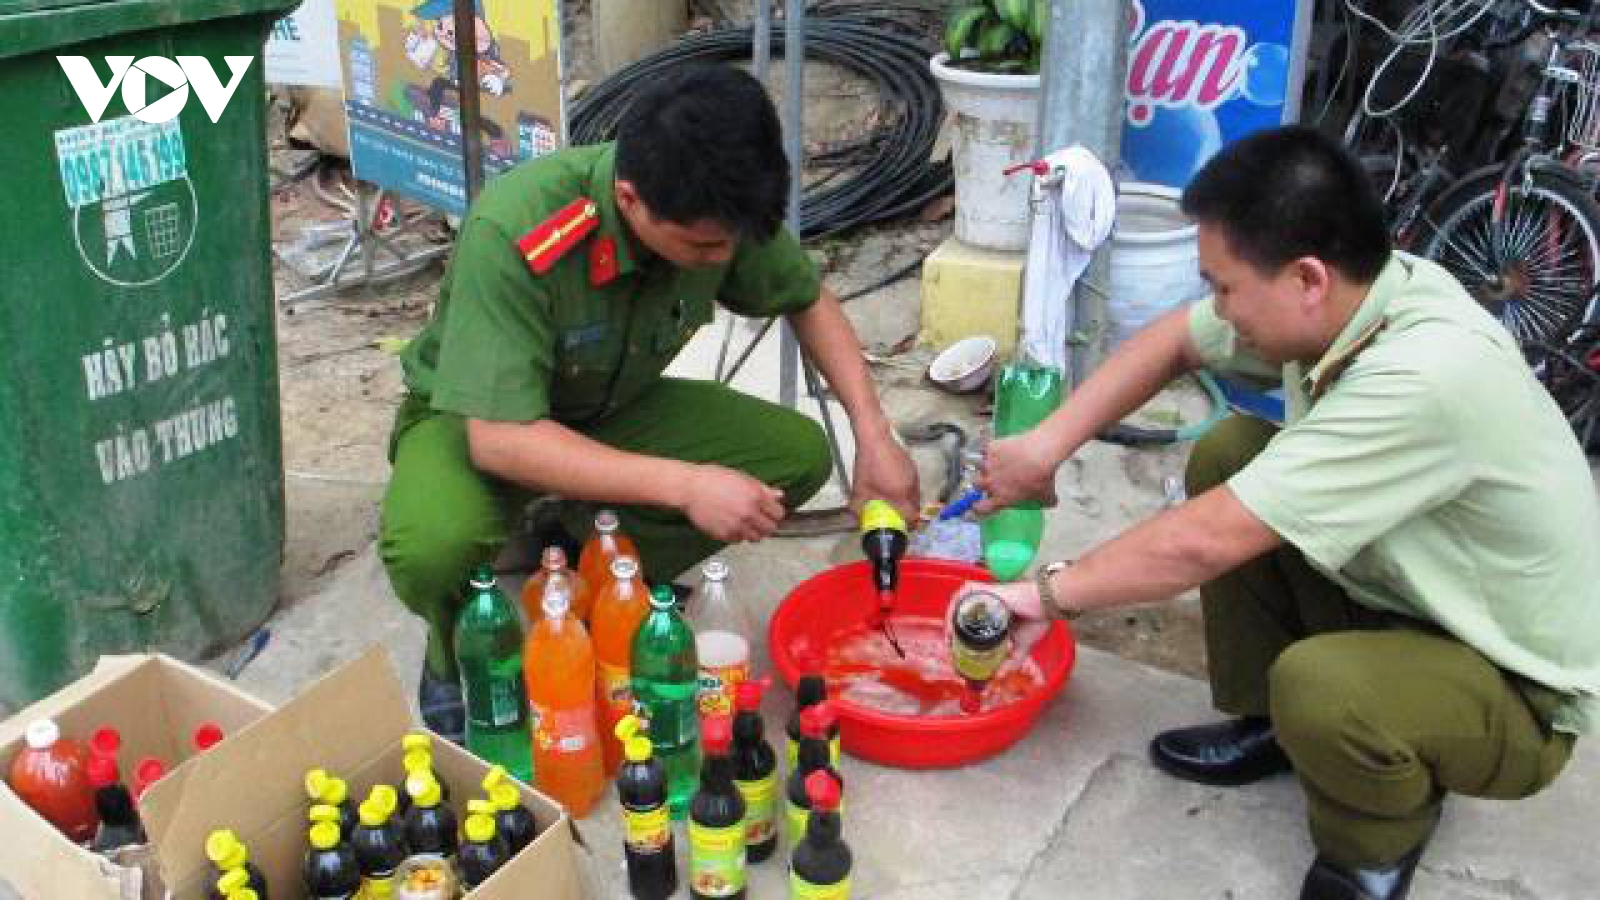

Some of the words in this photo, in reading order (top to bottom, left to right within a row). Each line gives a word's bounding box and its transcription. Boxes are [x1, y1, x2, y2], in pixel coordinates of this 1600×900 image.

[1124, 0, 1245, 127] ạn
[142, 312, 179, 381] BỎ
[95, 423, 151, 485] VÀO
[154, 396, 239, 463] THÙNG
